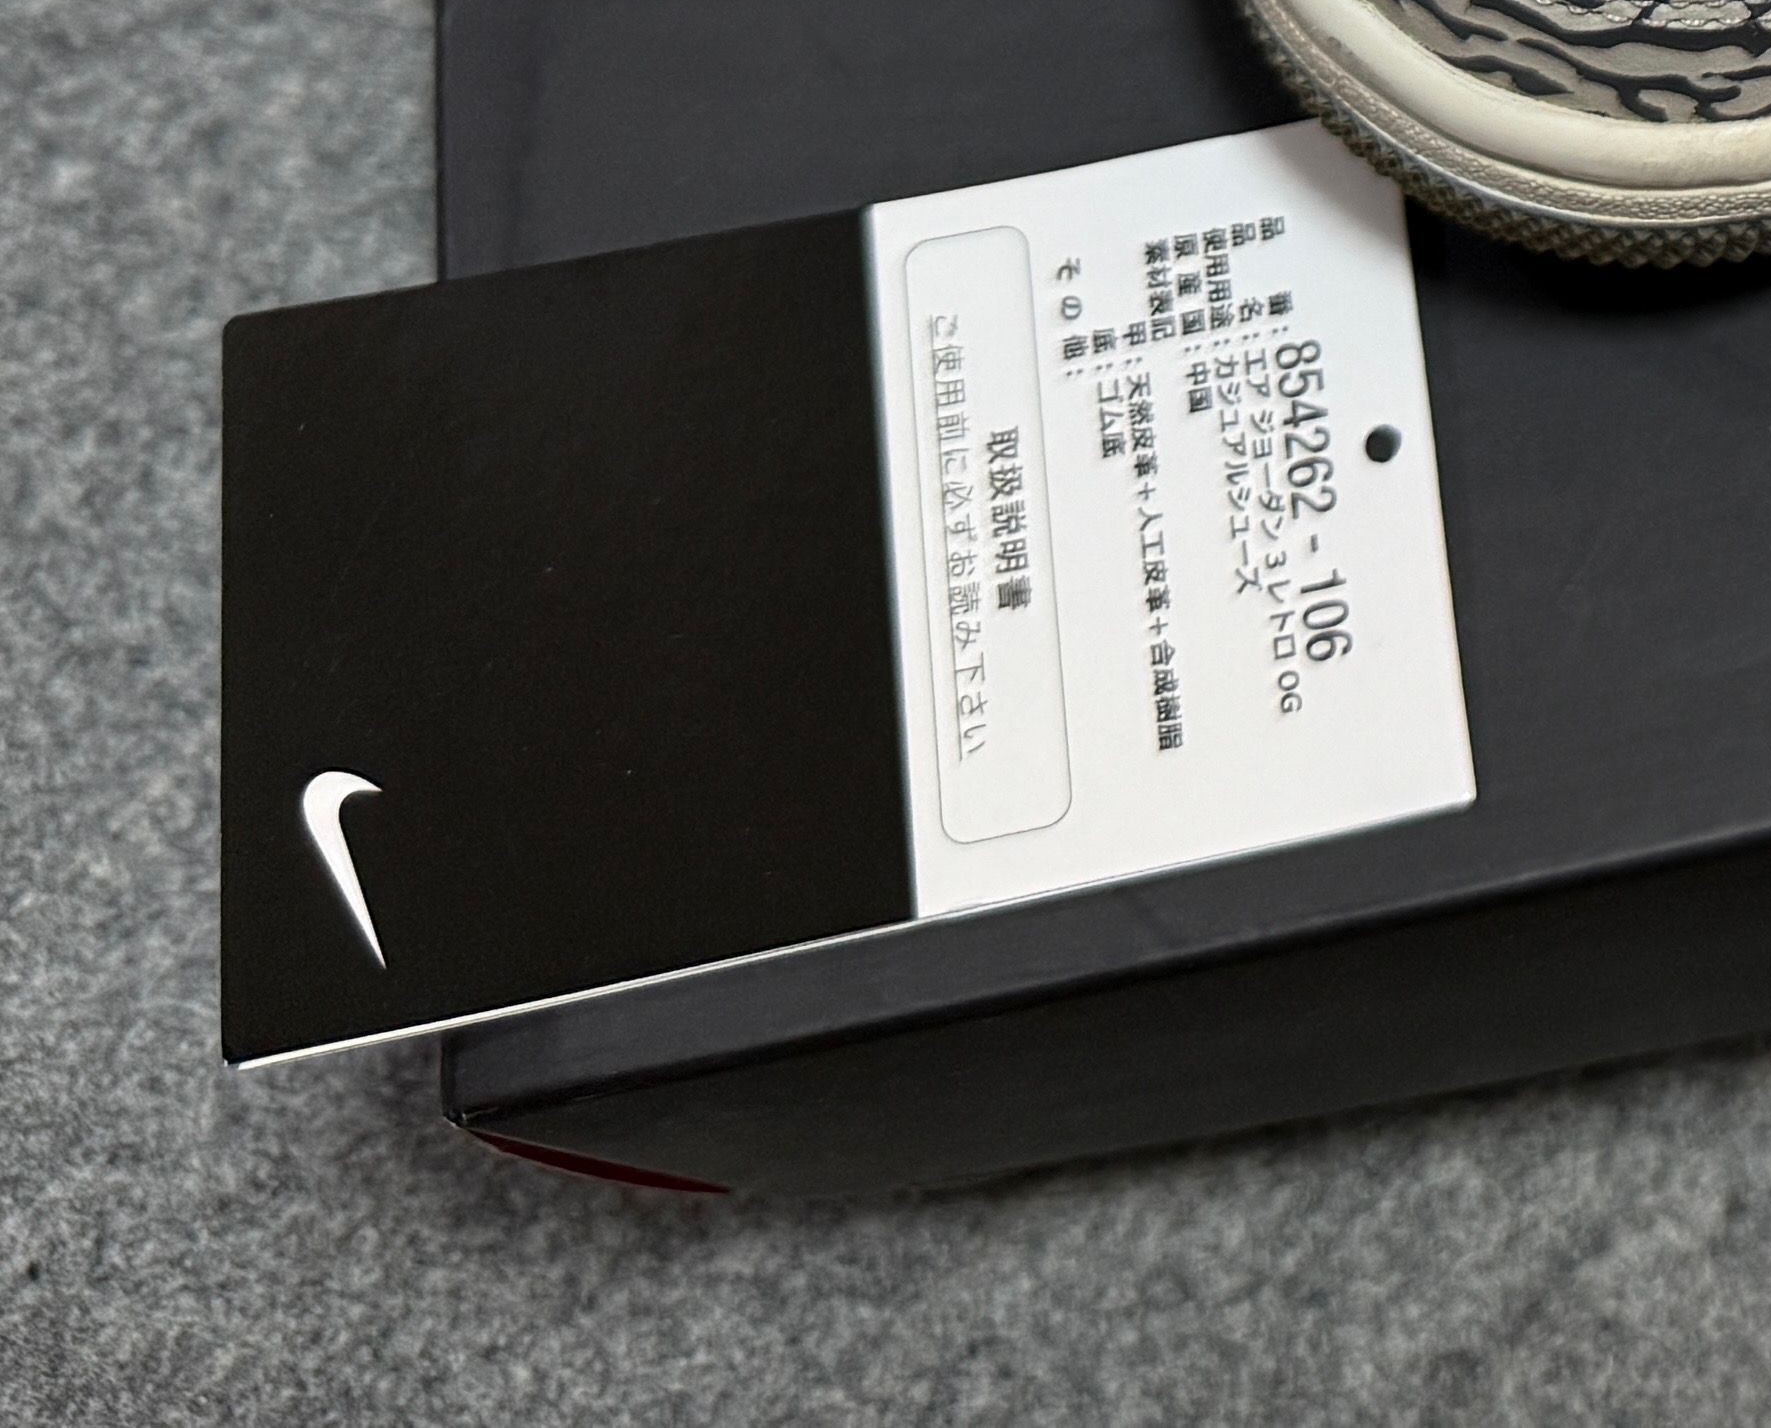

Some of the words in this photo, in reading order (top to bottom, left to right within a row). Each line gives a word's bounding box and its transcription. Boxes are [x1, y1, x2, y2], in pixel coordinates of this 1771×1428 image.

[986, 426, 1031, 610] 取扱説明書
[1274, 340, 1336, 520] 854262
[932, 314, 986, 754] ご使用前に必ずお読み下さい
[1300, 568, 1352, 662] 106
[1277, 670, 1301, 714] OG
